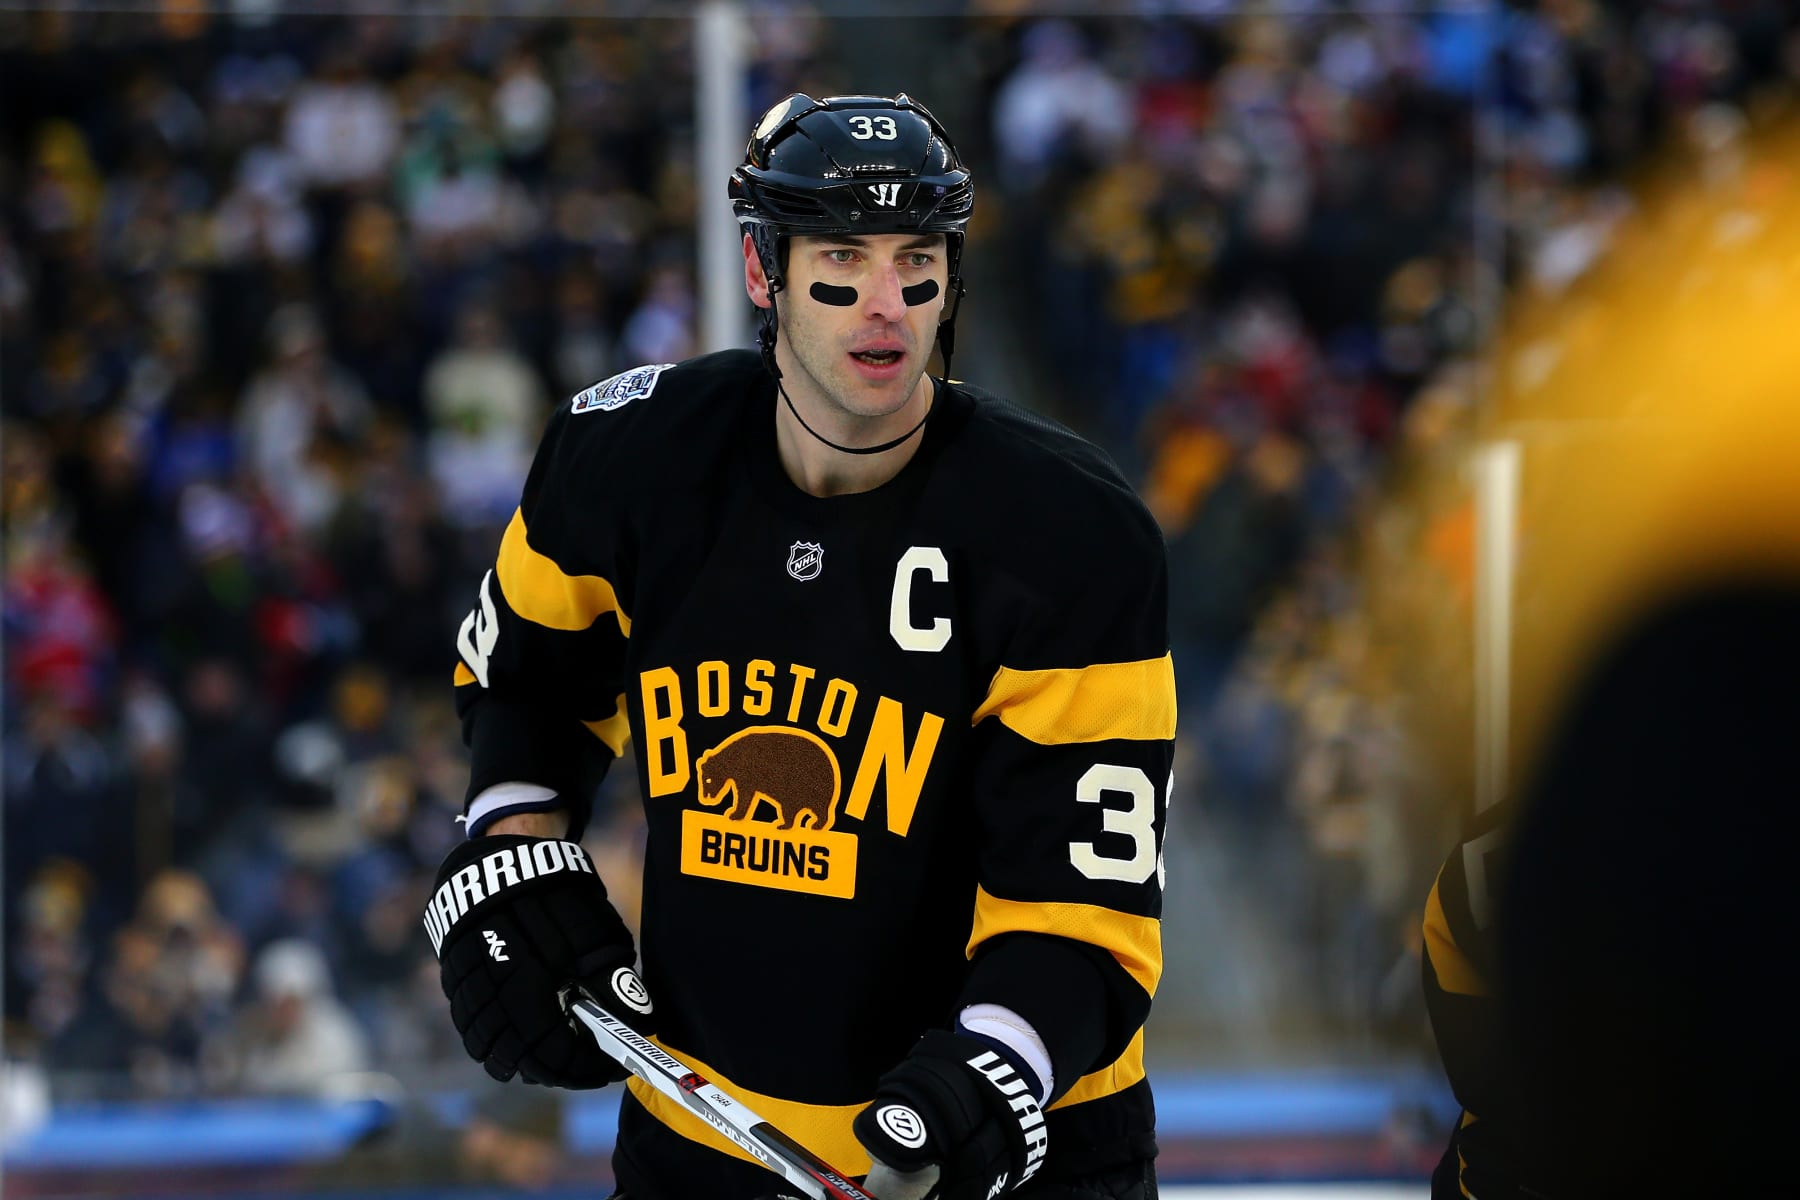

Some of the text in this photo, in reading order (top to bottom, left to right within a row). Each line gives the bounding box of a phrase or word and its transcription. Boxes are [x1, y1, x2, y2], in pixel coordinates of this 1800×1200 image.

[849, 115, 898, 141] 33
[889, 546, 952, 652] C
[640, 659, 945, 837] BOSTON
[700, 828, 830, 881] BRUINS
[1069, 763, 1174, 891] 3
[424, 840, 592, 959] WARRIOR
[613, 1027, 681, 1069] WARRIOR
